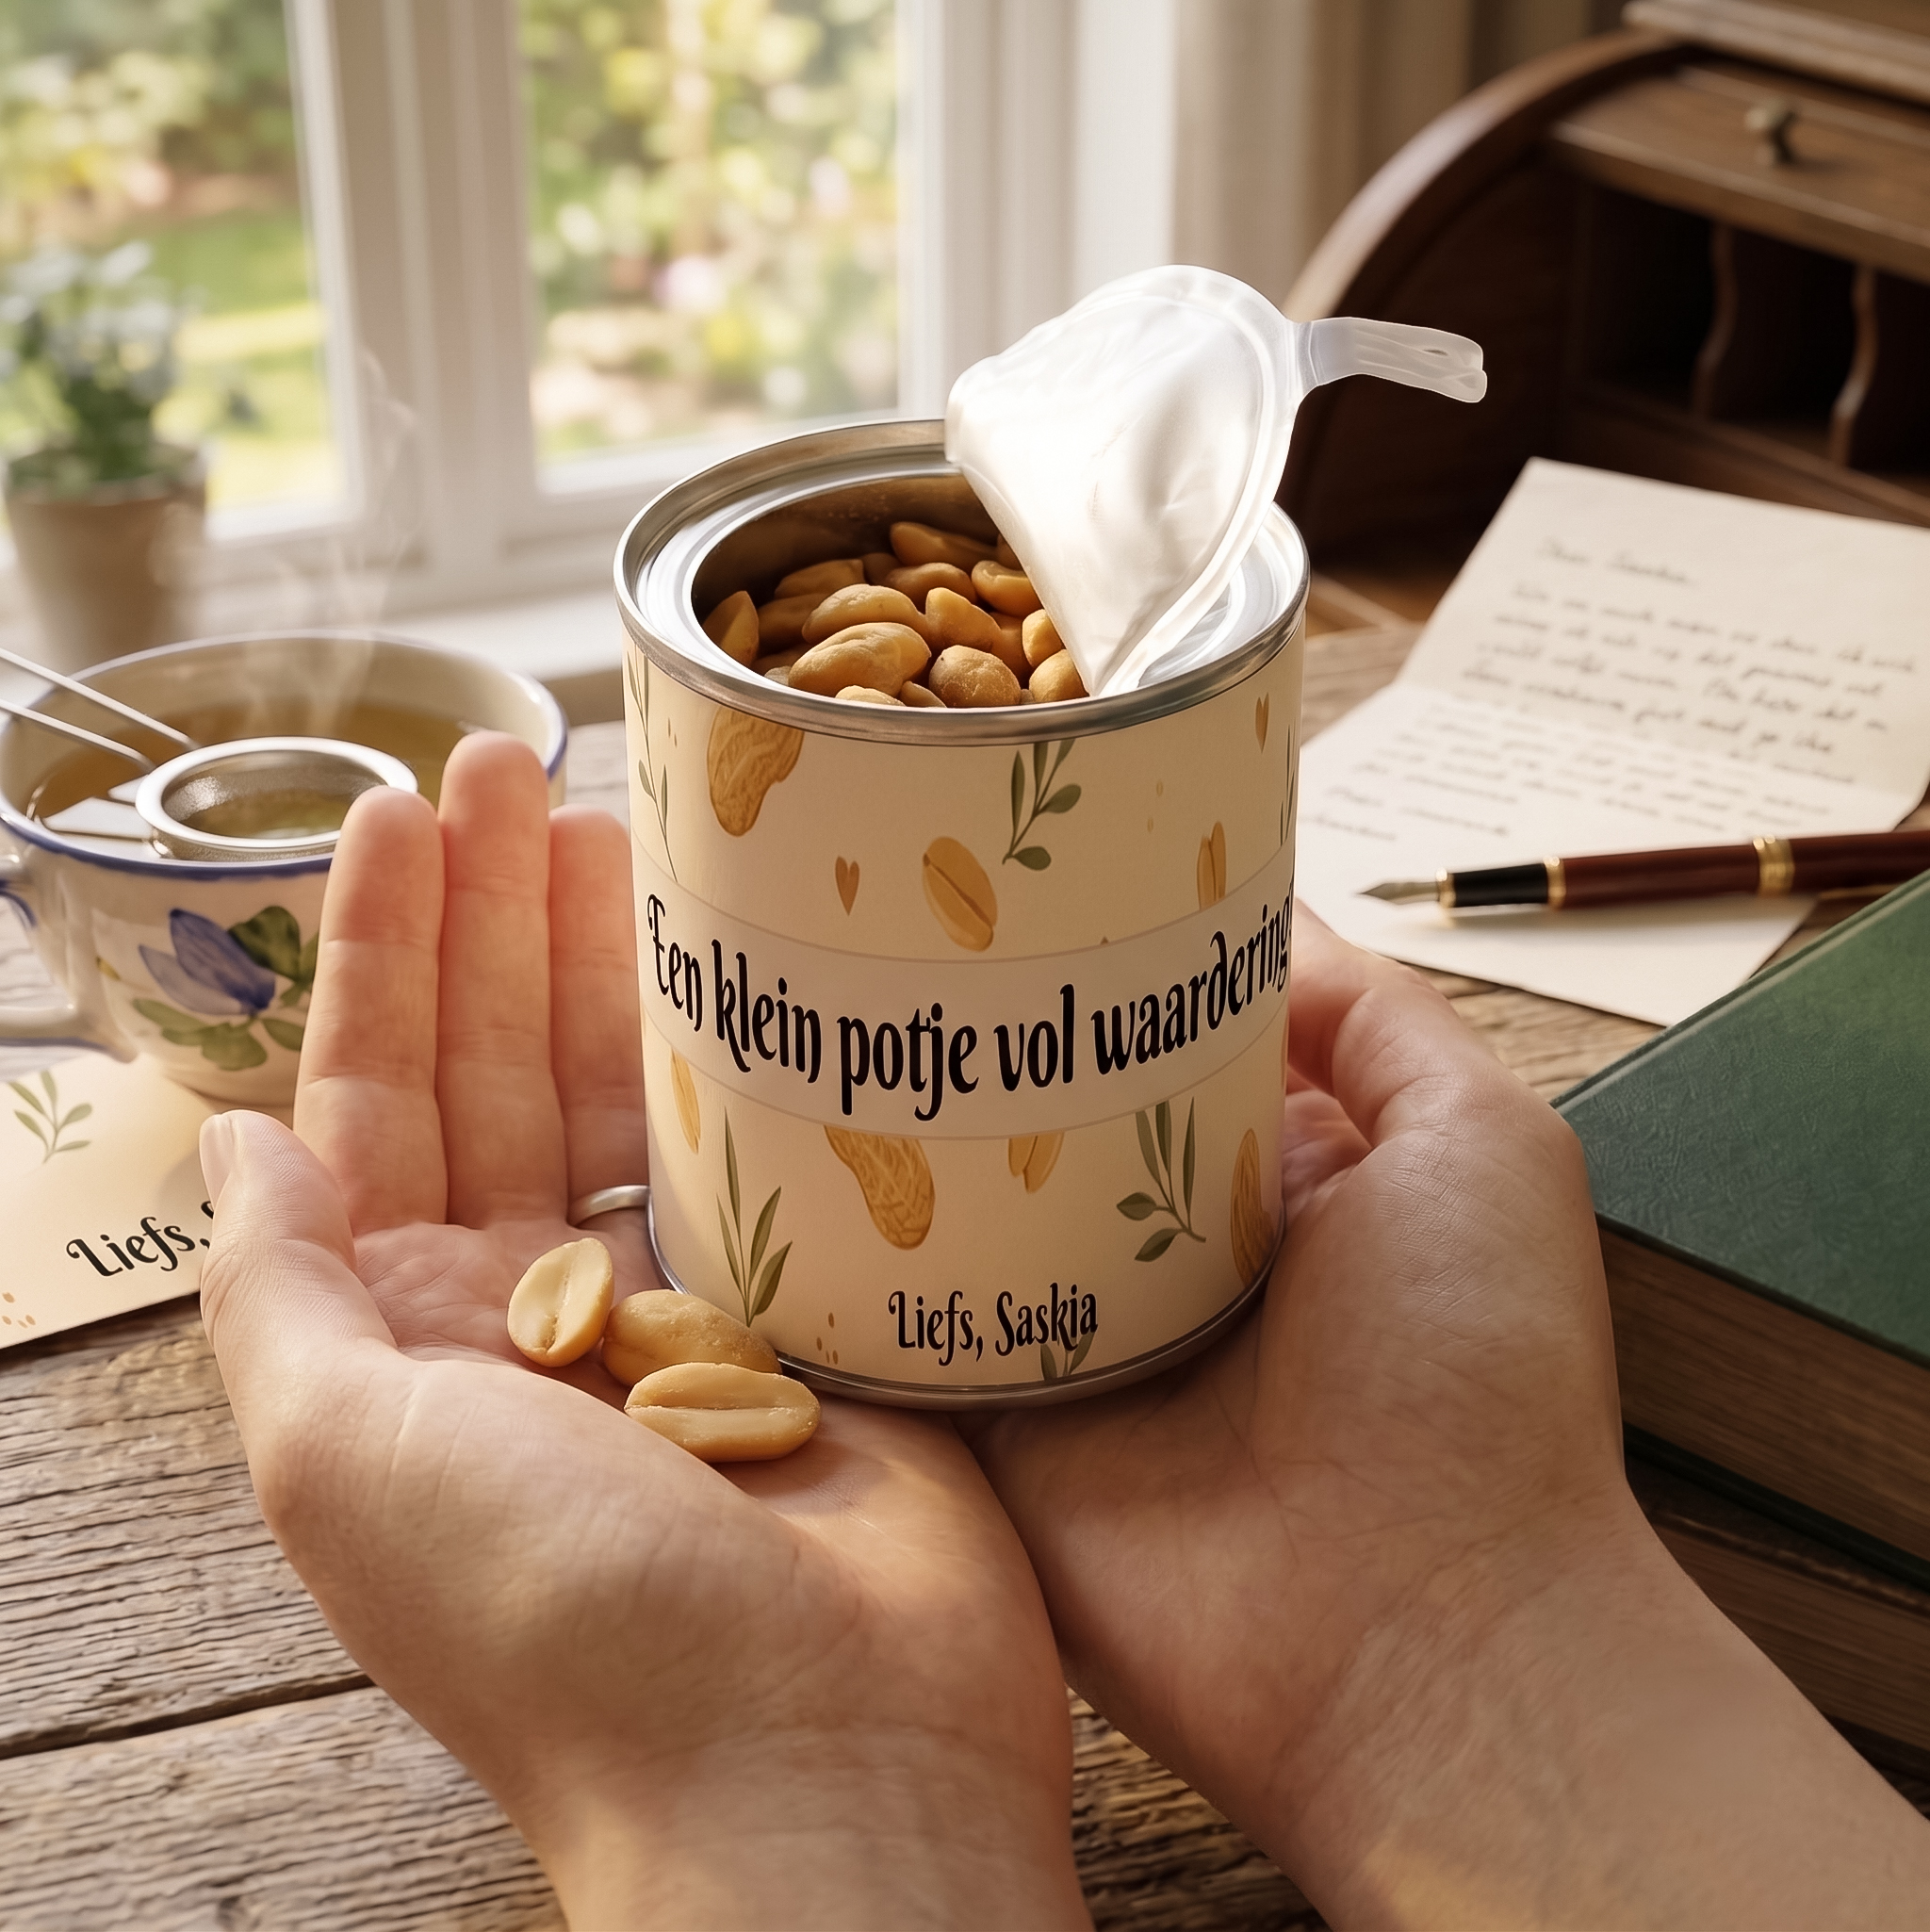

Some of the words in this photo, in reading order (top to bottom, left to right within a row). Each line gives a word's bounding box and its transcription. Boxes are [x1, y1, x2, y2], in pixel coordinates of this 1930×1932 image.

[647, 893, 703, 1032] Een
[711, 939, 822, 1085] klein
[836, 1002, 979, 1122] potje
[993, 983, 1075, 1092] vol
[888, 1290, 984, 1367] Liefs,
[995, 1282, 1099, 1357] Saskia
